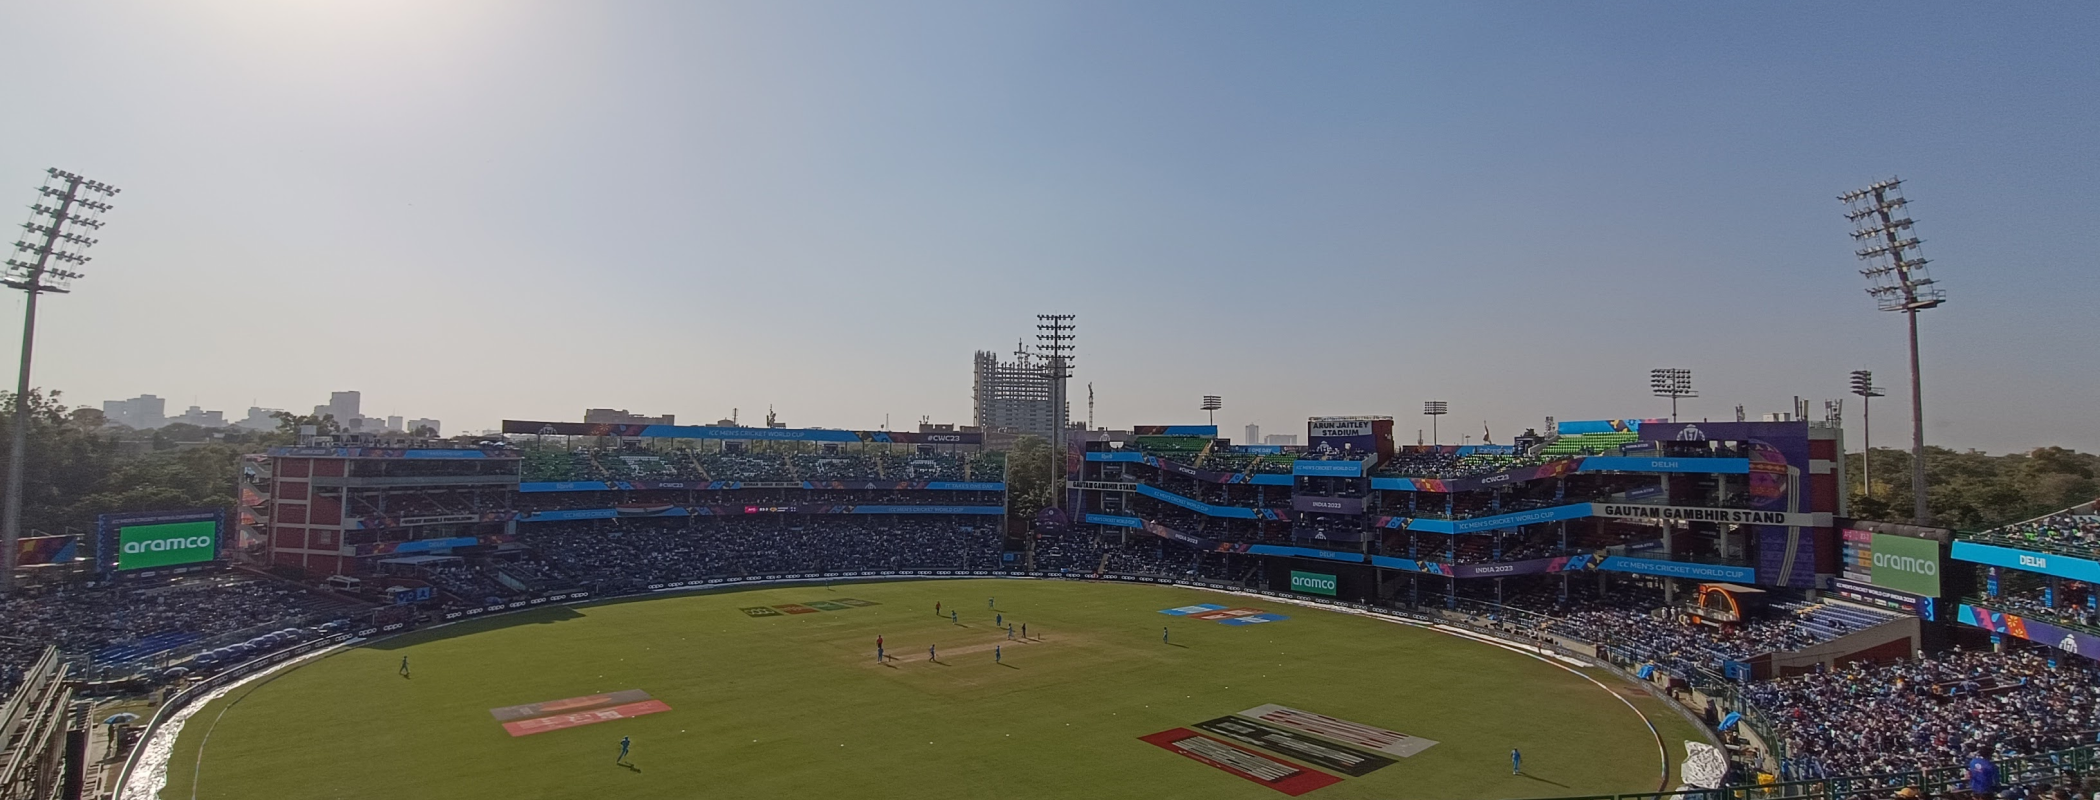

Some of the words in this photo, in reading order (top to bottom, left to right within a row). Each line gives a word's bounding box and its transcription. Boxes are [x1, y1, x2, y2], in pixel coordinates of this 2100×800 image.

[1481, 474, 1510, 484] #CWC23
[1605, 506, 1659, 518] GAUTAM
[1663, 507, 1729, 521] GAMBHIR
[1732, 511, 1785, 524] STAND
[1469, 521, 1487, 529] MEN'S
[1488, 518, 1514, 526] CRICKET
[1515, 514, 1540, 522] WORLD
[124, 536, 211, 554] aramco
[1873, 552, 1936, 576] aramco
[2020, 555, 2046, 568] DELHI
[1475, 566, 1494, 574] INDIA
[1630, 562, 1654, 570] MEN'S
[1656, 564, 1690, 574] CRICKET
[1692, 567, 1724, 577] WORLD
[1725, 570, 1744, 578] CUP
[1292, 576, 1335, 590] aramco
[467, 607, 483, 615] oppo
[359, 627, 377, 636] oppo
[383, 623, 403, 631] oppo
[1474, 626, 1489, 634] oppo
[1494, 631, 1510, 639] oppo
